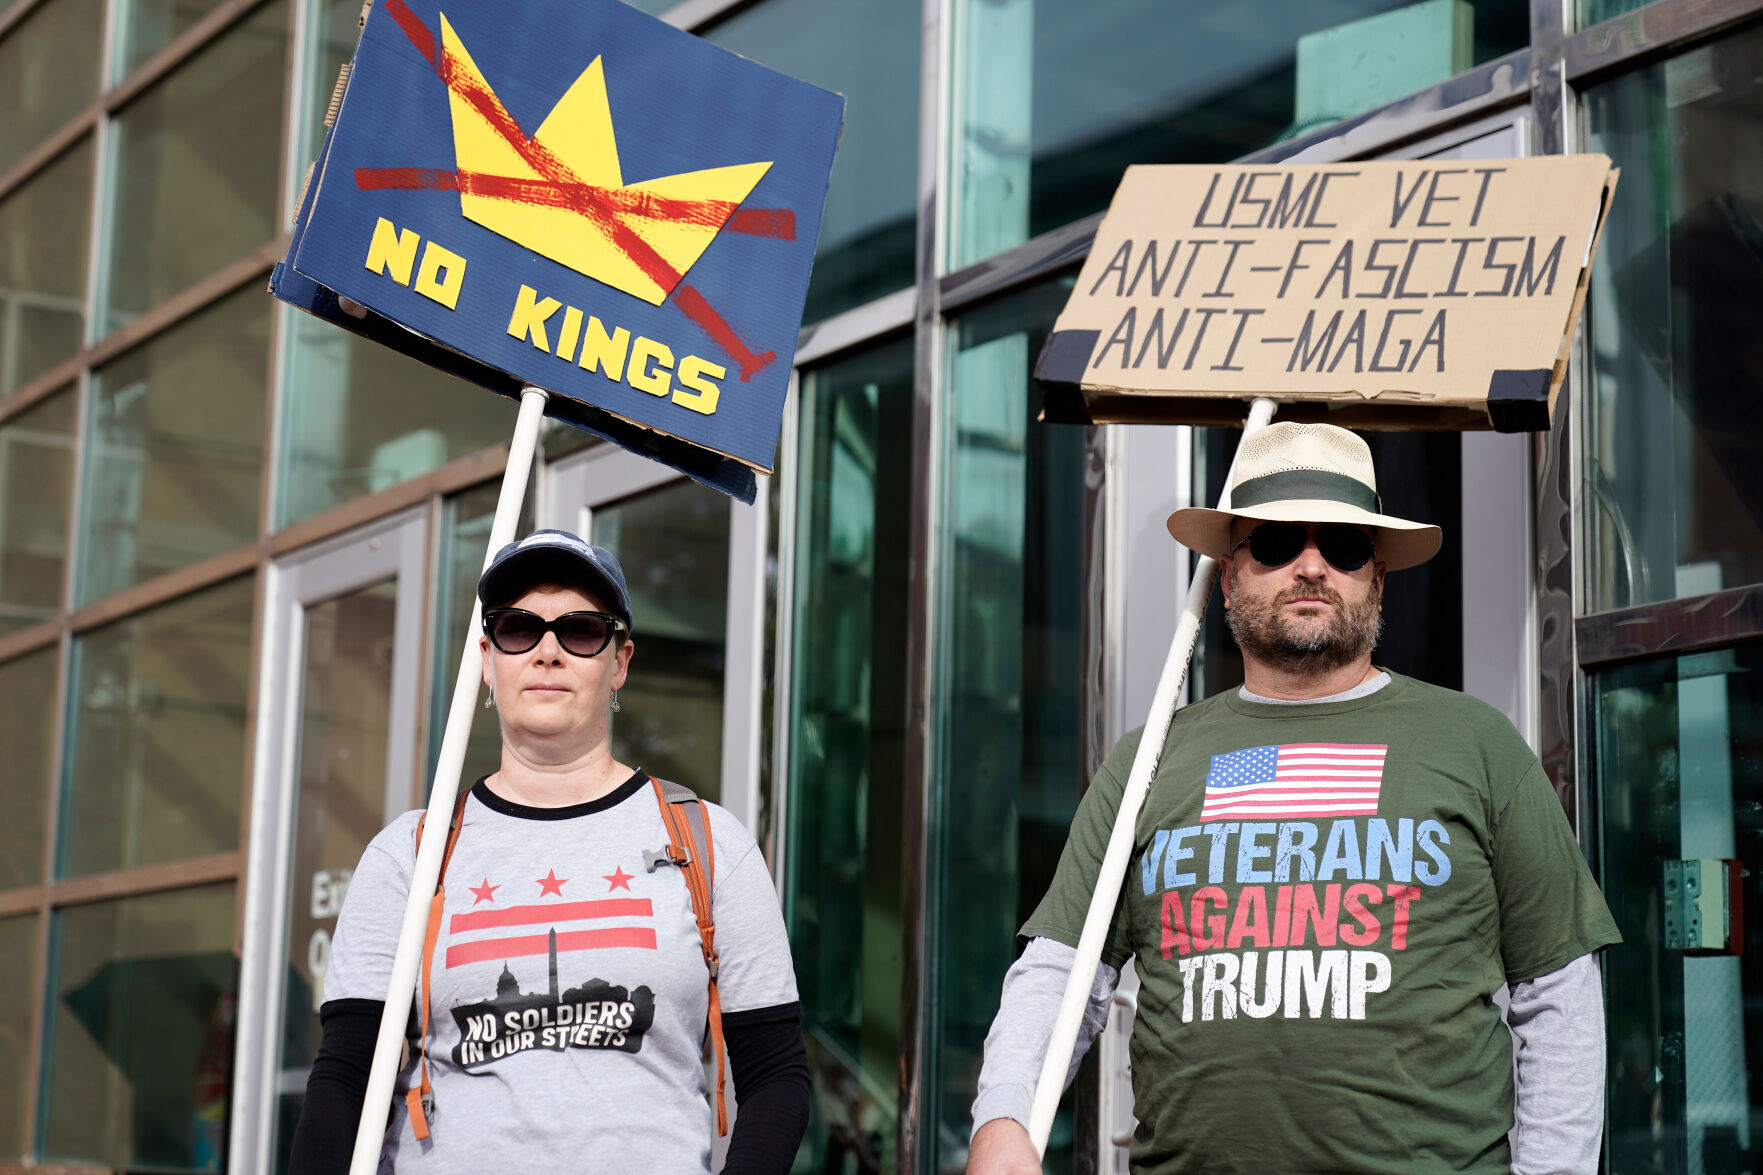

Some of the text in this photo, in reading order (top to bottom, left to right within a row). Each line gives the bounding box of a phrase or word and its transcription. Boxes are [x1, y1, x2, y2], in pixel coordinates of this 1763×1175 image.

[1193, 168, 1507, 229] USMC VET
[1089, 235, 1567, 299] ANTI-FASCISM
[364, 216, 726, 416] NO KINGS
[1092, 306, 1447, 373] ANTI-MAGA
[1141, 817, 1452, 896] VETERANS
[1160, 883, 1421, 961] AGAINST
[1178, 950, 1392, 1023] TRUMP
[461, 1023, 630, 1065] IN OUR STREETS
[465, 1001, 636, 1043] NO SOLDIERS
